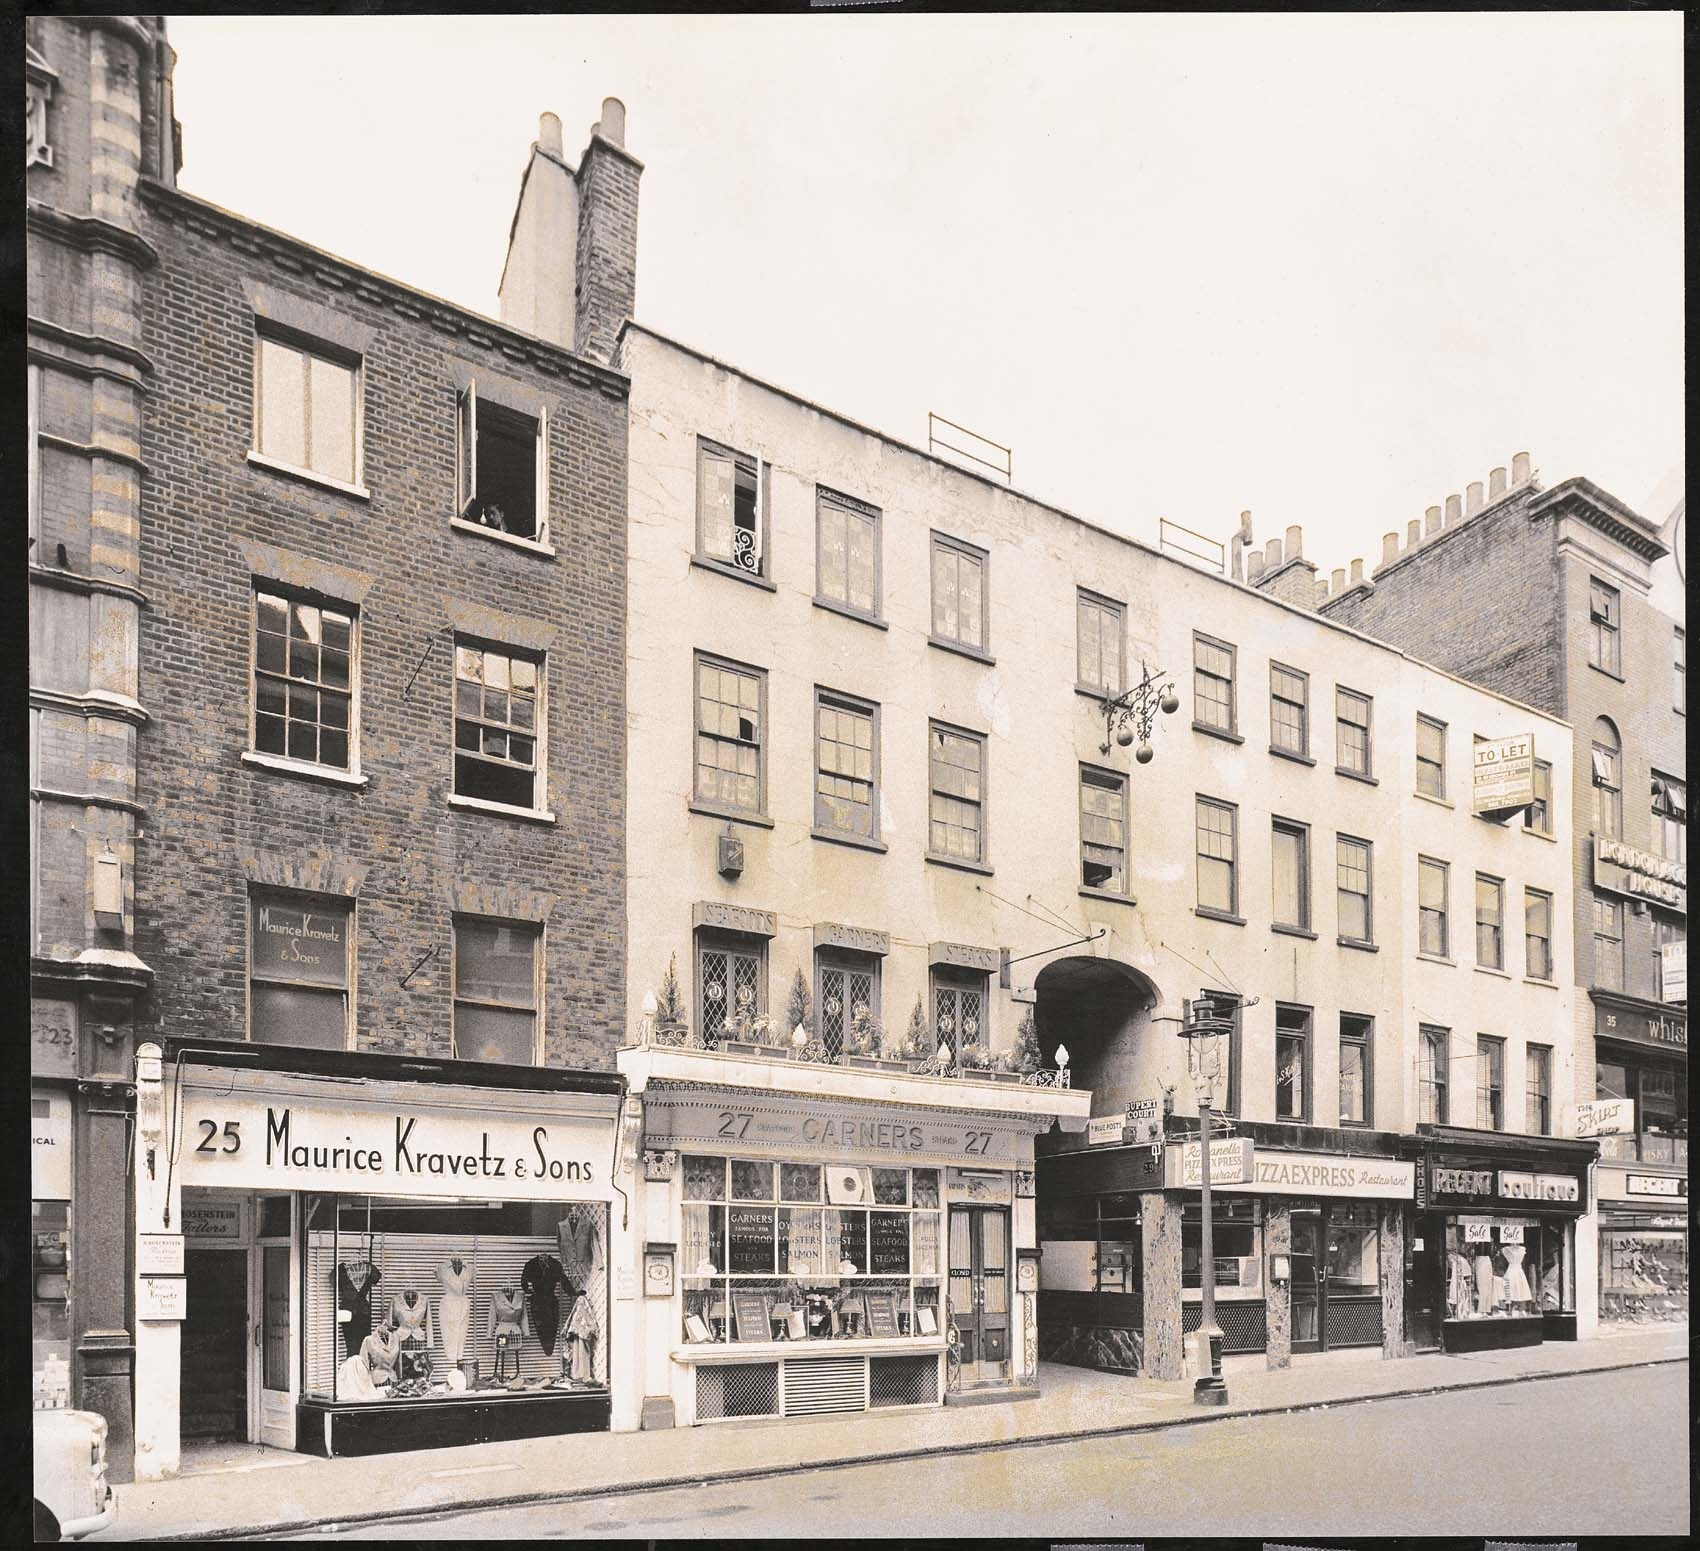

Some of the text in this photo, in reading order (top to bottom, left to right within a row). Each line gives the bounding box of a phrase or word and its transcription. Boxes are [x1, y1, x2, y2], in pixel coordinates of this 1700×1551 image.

[1477, 743, 1527, 763] TO LET
[259, 906, 340, 943] Maurice Kravetz
[291, 937, 321, 965] Sons
[1606, 1014, 1617, 1028] 35
[1125, 1100, 1157, 1112] RUPERT
[1127, 1109, 1155, 1119] COURT
[1577, 1105, 1621, 1133] SKIRT
[718, 1111, 754, 1139] 27
[802, 1117, 924, 1150] GARNERS
[964, 1131, 993, 1155] 27
[195, 1107, 592, 1181] 25 Maurice Kravetz & Sons
[1184, 1155, 1242, 1170] PIZZXPRESS
[1255, 1162, 1408, 1188] IZZAEXPRESS Restaurant
[1417, 1156, 1425, 1209] SHOES
[1432, 1168, 1493, 1195] REGENT
[1499, 1170, 1578, 1202] boutique
[731, 1214, 773, 1224] GARNERS
[731, 1234, 773, 1244] SEAFOOD
[1469, 1225, 1487, 1240] Sale
[1503, 1226, 1521, 1240] Sale
[871, 1237, 910, 1247] SEAFOOD
[734, 1252, 770, 1262] STEAKS
[782, 1250, 819, 1259] SALMON
[874, 1254, 906, 1263] STEAKS
